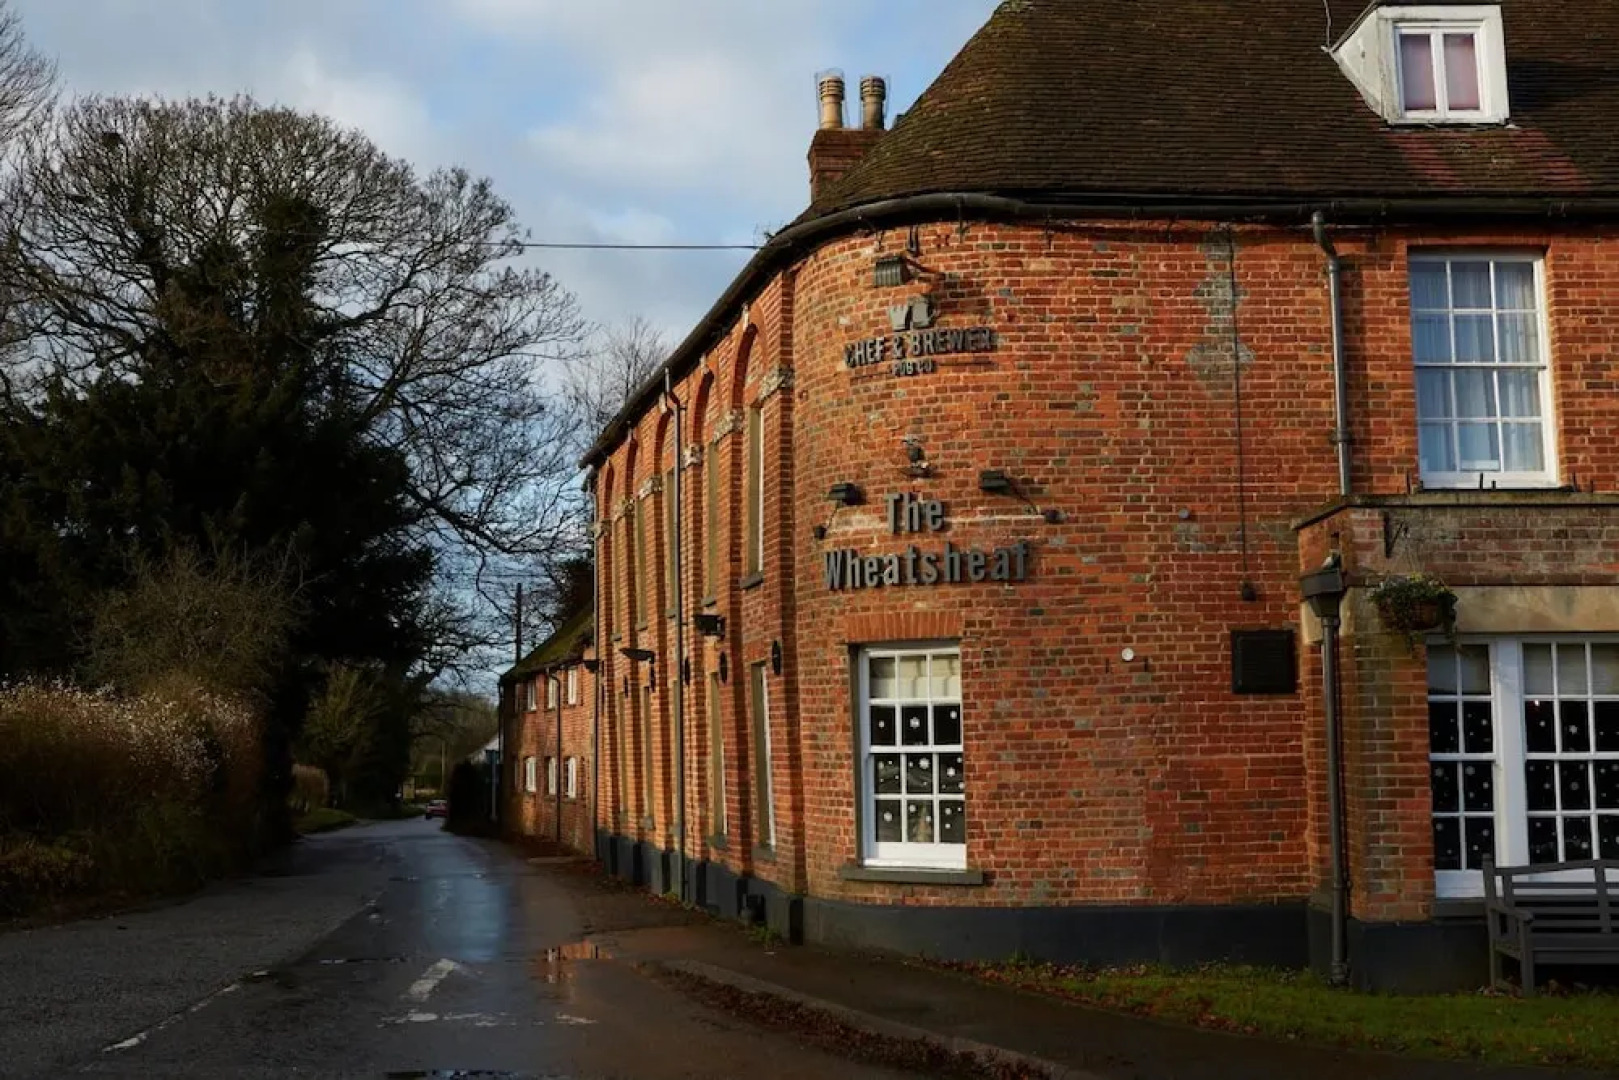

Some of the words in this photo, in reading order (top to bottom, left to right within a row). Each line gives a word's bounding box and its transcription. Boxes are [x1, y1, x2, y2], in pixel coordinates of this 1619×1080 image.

[845, 337, 885, 367] CHEF
[910, 327, 991, 356] BREWER
[884, 491, 945, 534] The
[824, 541, 1030, 590] Wheatsheaf
